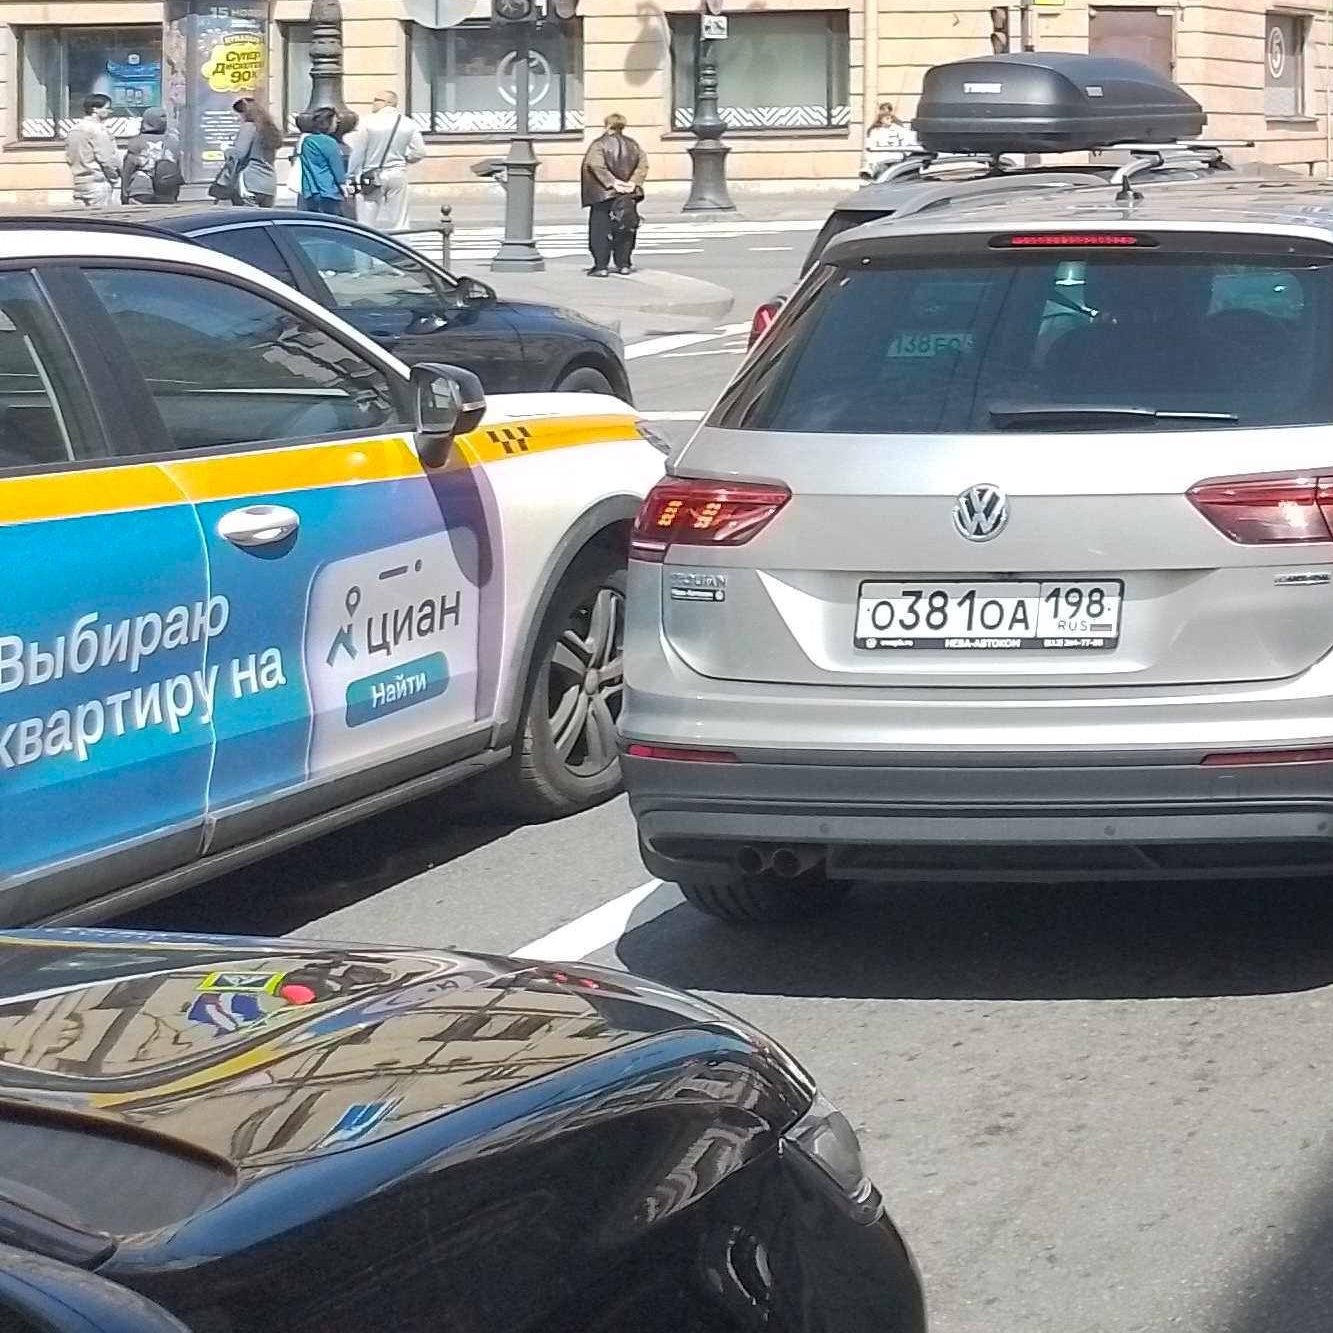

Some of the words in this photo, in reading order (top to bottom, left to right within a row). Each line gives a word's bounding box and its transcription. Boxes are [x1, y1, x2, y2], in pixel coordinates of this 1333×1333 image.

[367, 590, 461, 656] циан
[1044, 587, 1104, 619] 198
[1058, 620, 1087, 631] RUS
[0, 594, 230, 694] Выбираю
[231, 646, 287, 699] на
[371, 671, 427, 709] Найти
